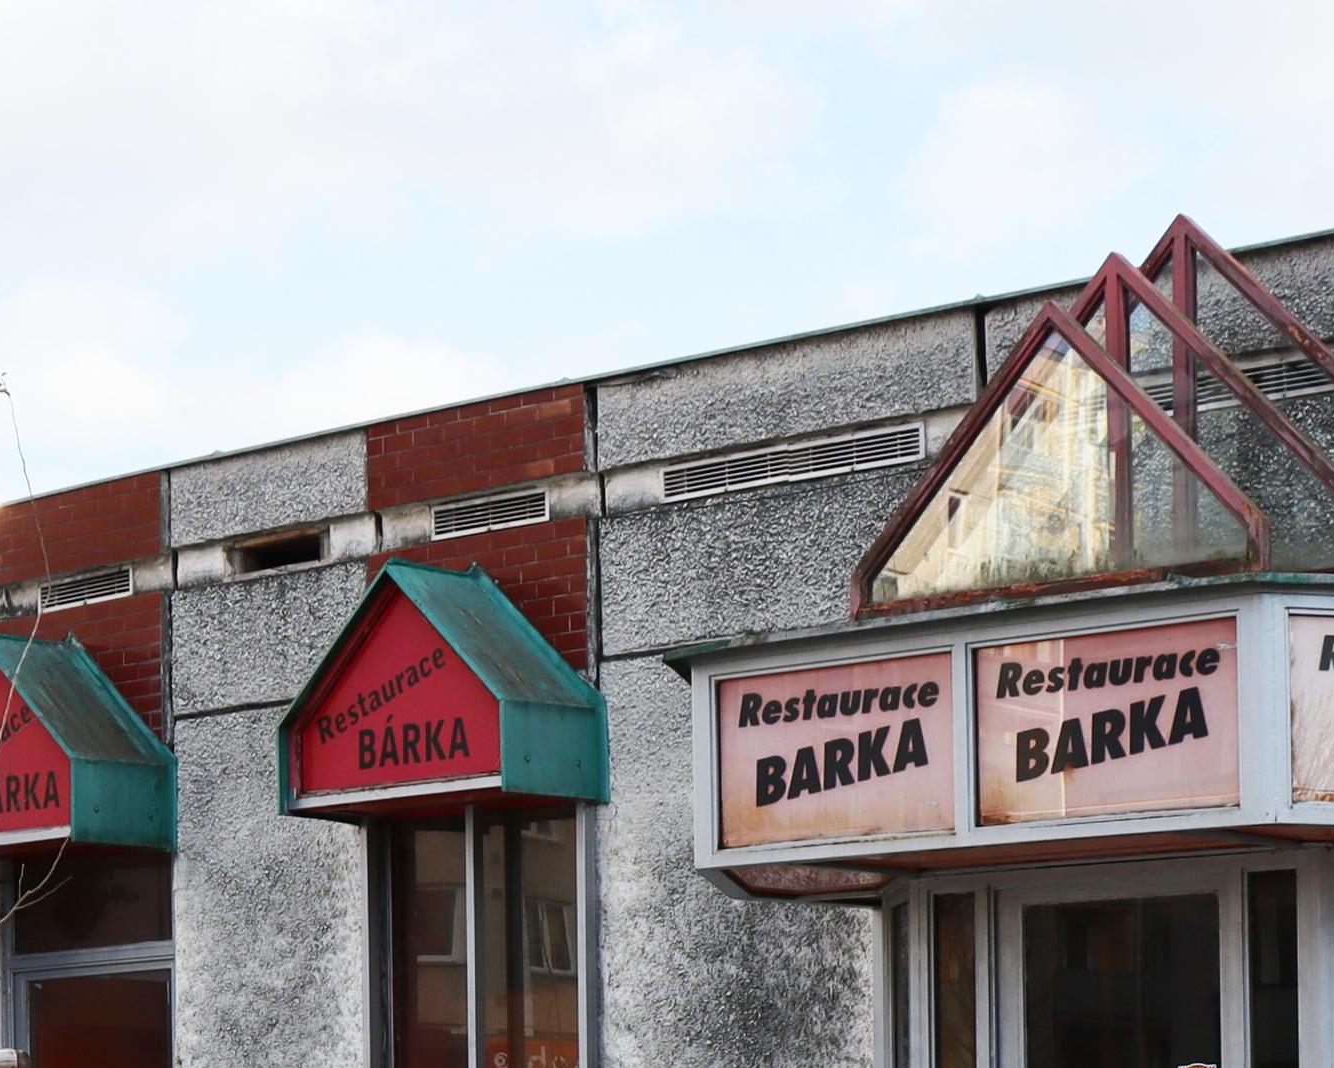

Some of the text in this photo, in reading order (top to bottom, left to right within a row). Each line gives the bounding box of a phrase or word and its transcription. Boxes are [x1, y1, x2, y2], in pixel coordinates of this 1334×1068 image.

[317, 647, 447, 745] Restaurace
[738, 681, 940, 728] Restaurace
[996, 648, 1221, 699] Restaurace
[358, 714, 470, 770] BÁRKA
[755, 717, 929, 808] BARKA
[1016, 686, 1209, 783] BARKA
